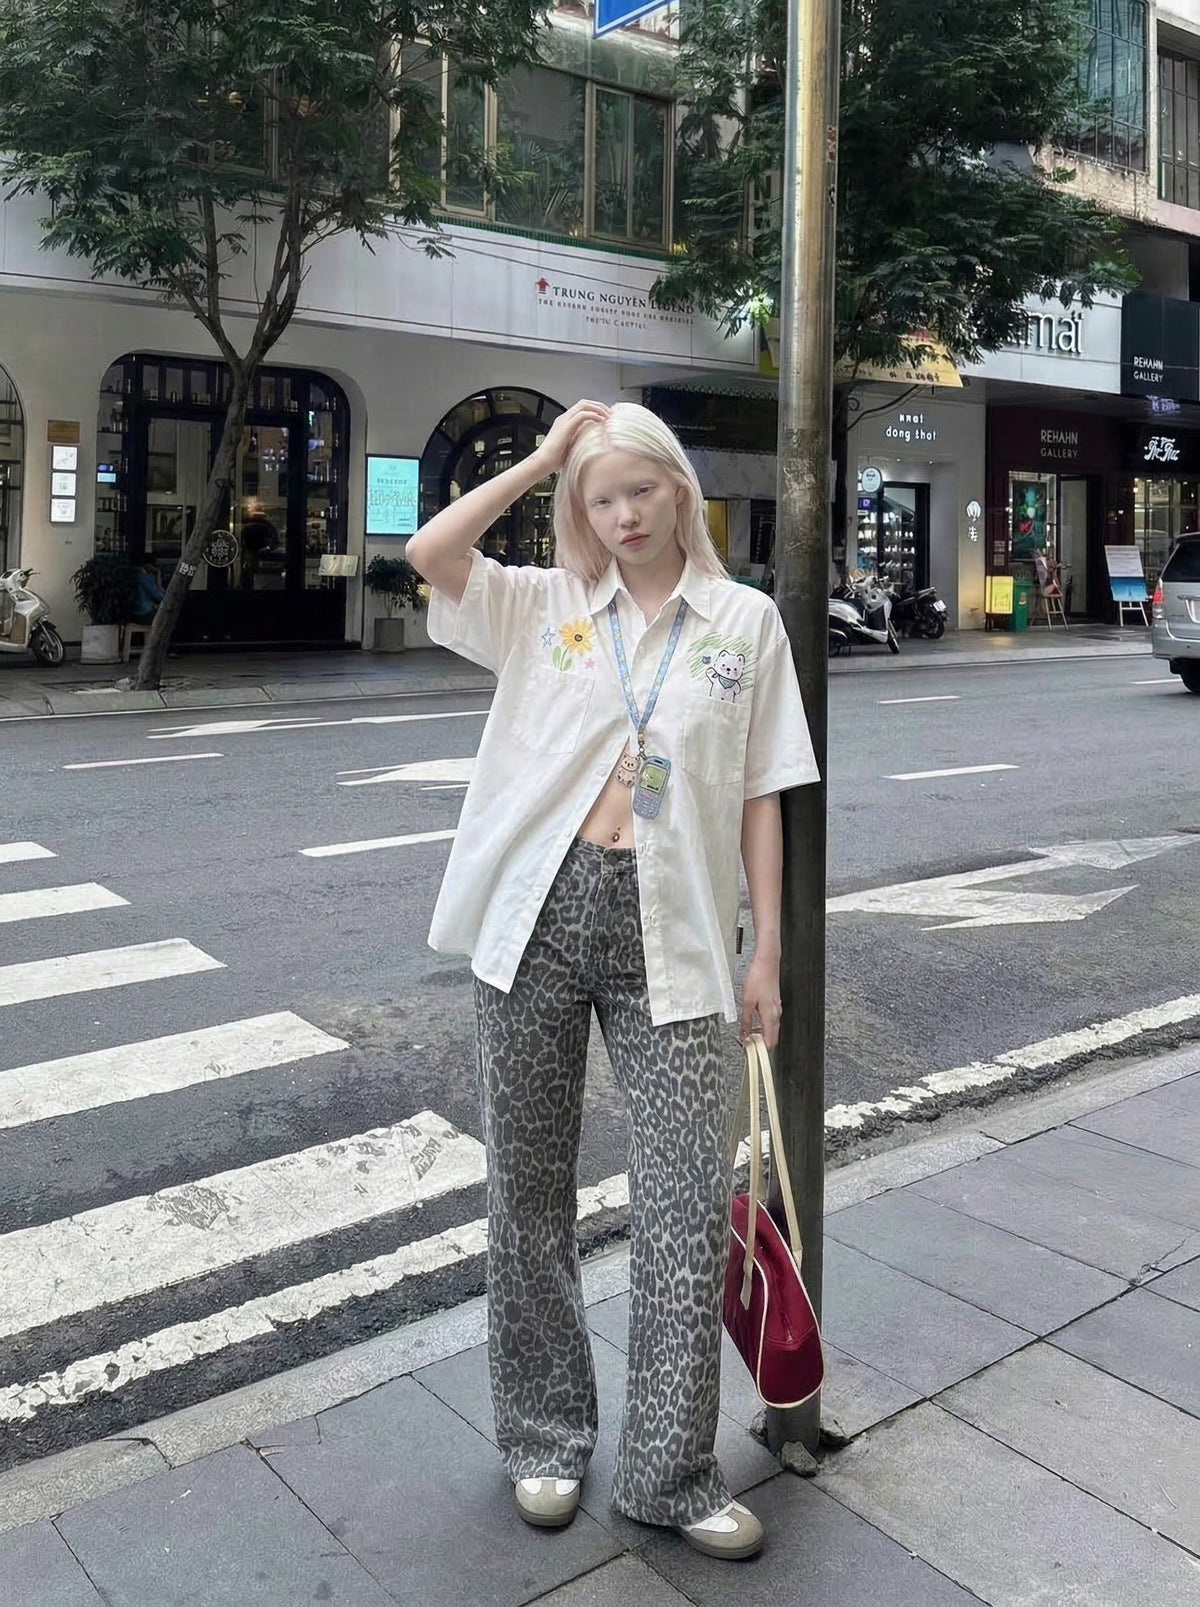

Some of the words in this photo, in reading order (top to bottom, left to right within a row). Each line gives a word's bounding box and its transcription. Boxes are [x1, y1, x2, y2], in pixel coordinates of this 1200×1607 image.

[553, 286, 595, 302] TRUNG
[1133, 356, 1164, 370] REHAHN
[1133, 370, 1164, 382] GALLERY
[1040, 429, 1078, 445] REHAHN
[1040, 447, 1078, 459] GALLERY
